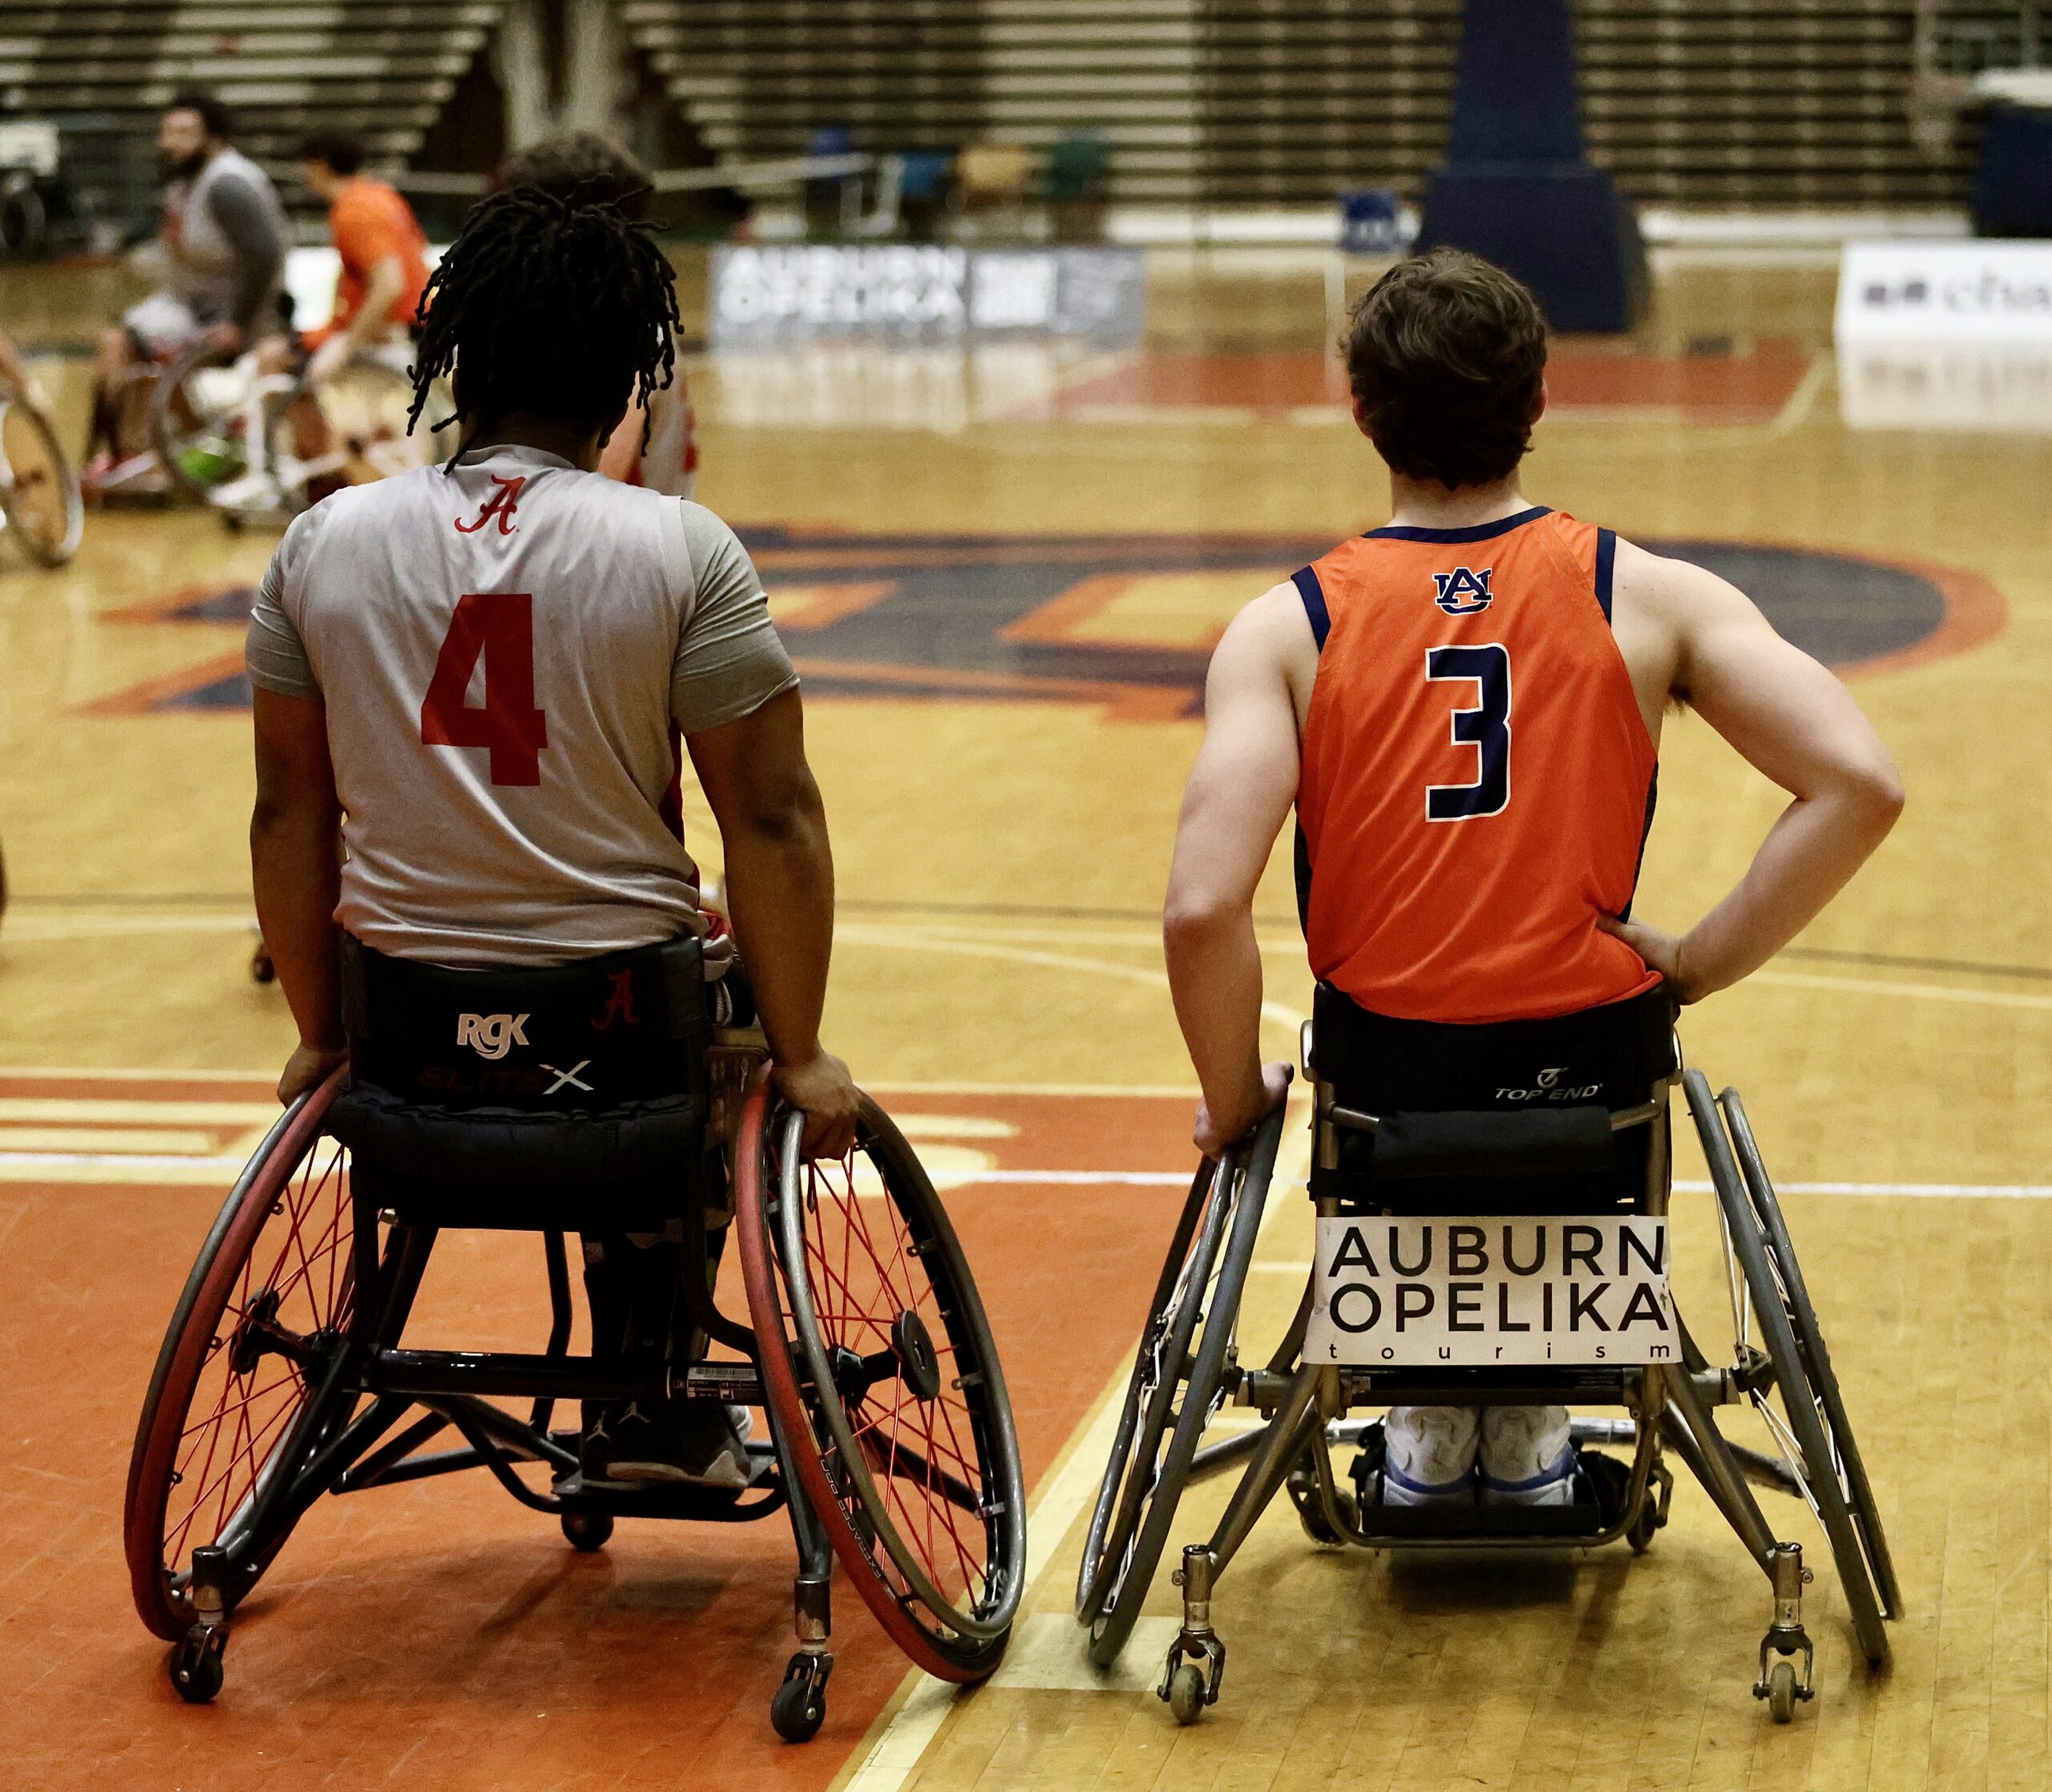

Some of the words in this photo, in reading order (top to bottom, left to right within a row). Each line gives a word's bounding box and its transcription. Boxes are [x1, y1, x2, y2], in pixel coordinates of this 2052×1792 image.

[454, 474, 526, 535] A
[421, 593, 548, 786] 4
[1425, 642, 1513, 822] 3
[1495, 1088, 1544, 1101] TOP
[1547, 1084, 1599, 1100] END
[1327, 1225, 1666, 1277] AUBURN
[1328, 1281, 1670, 1334] OPELIKA
[1328, 1342, 1670, 1360] tourism
